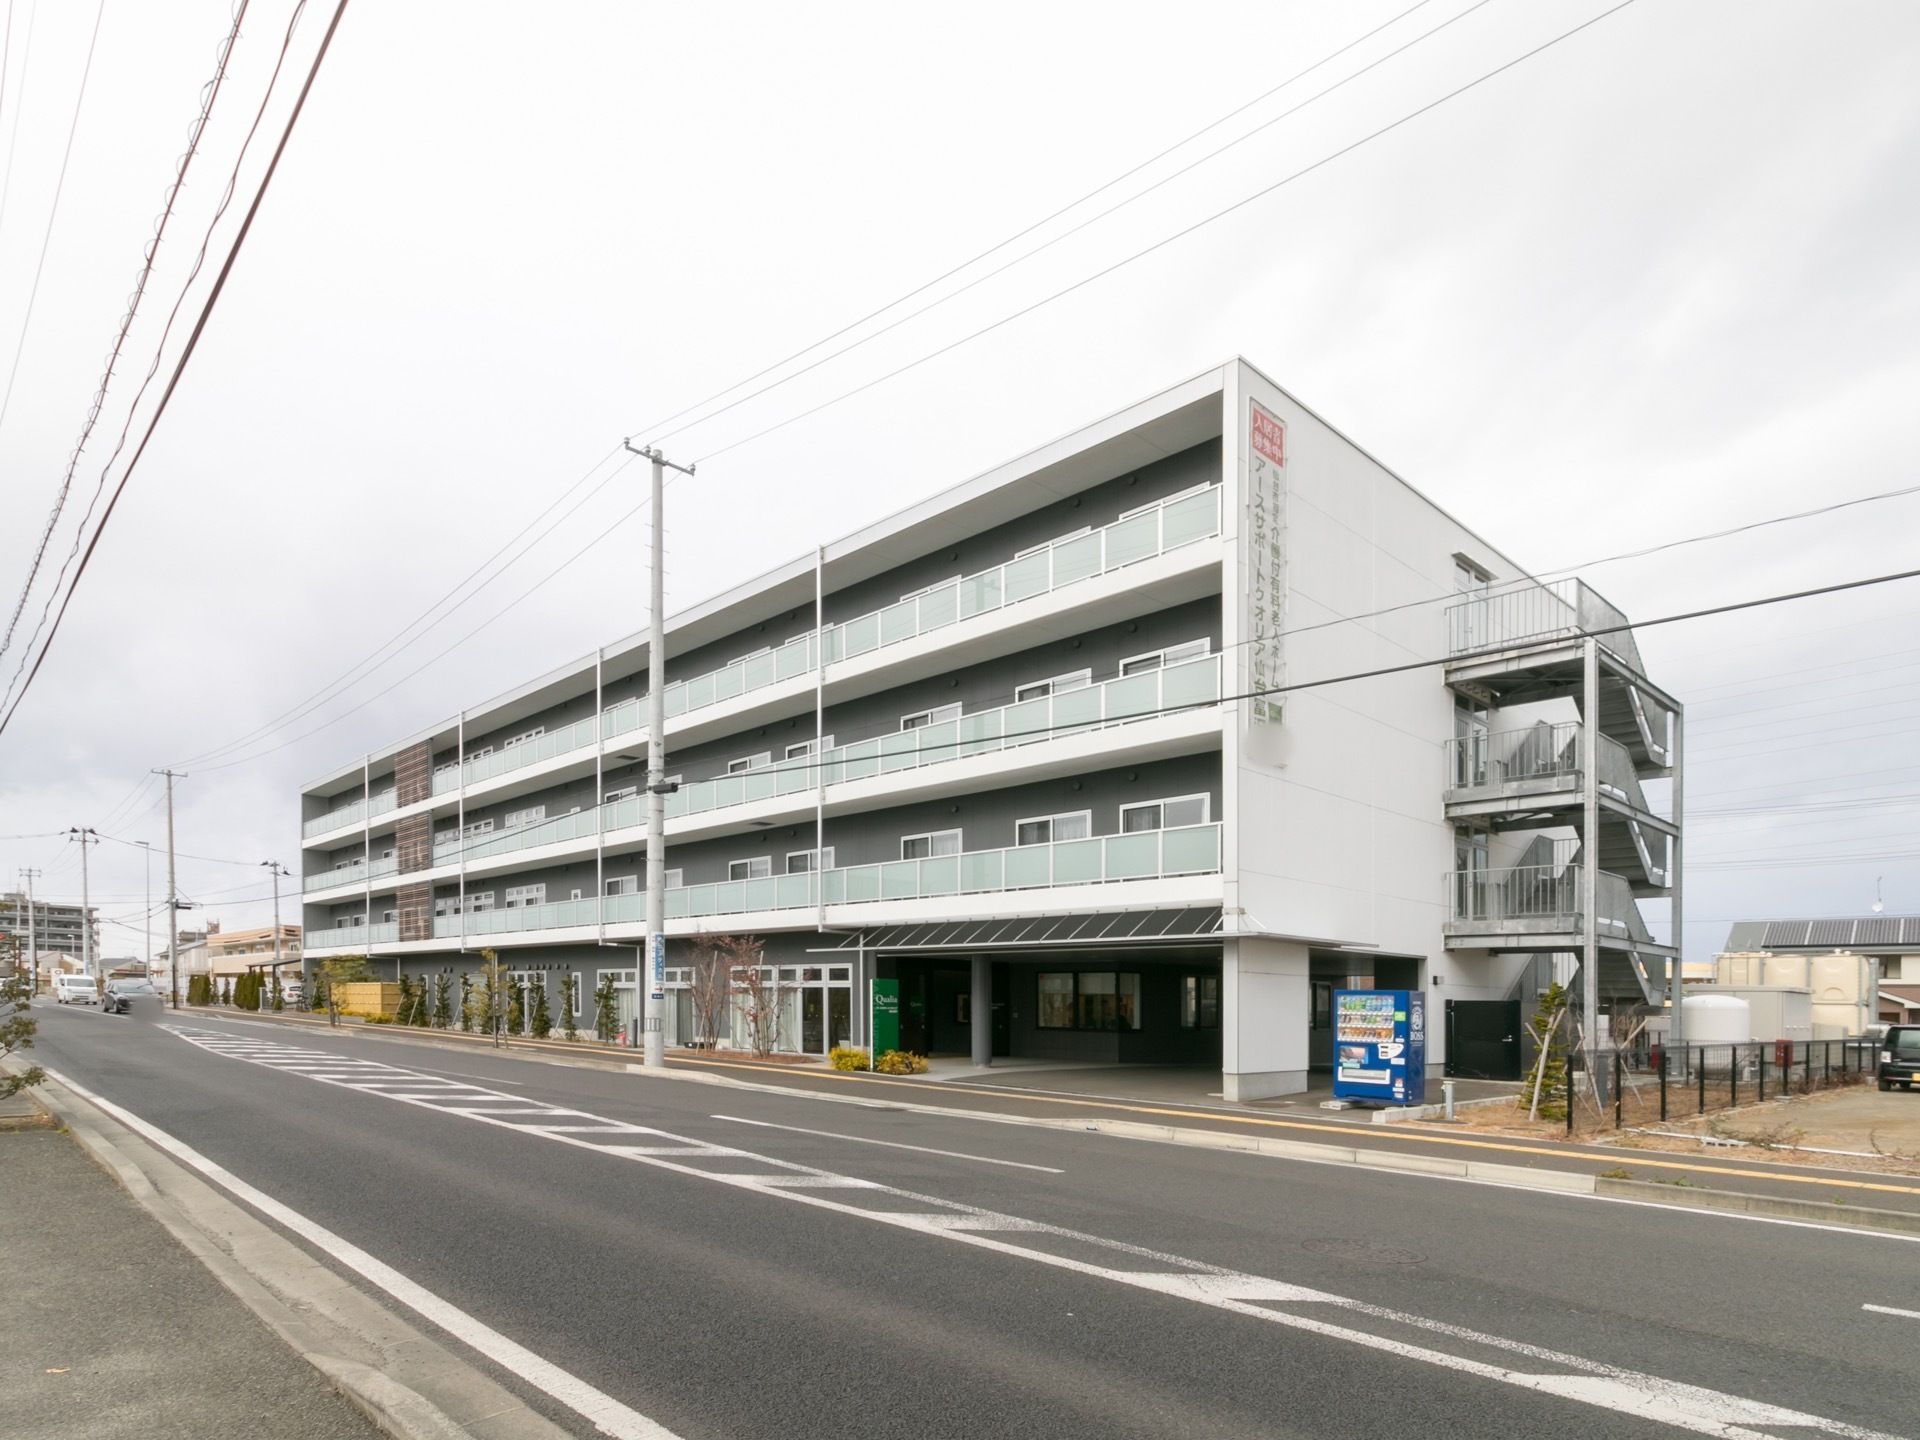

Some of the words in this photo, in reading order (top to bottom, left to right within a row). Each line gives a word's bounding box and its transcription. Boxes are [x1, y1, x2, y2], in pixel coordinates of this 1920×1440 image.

[1254, 410, 1281, 445] 入居者
[1253, 430, 1282, 462] 募集中
[875, 994, 898, 1006] Qualia
[1410, 1031, 1424, 1041] BOSS
